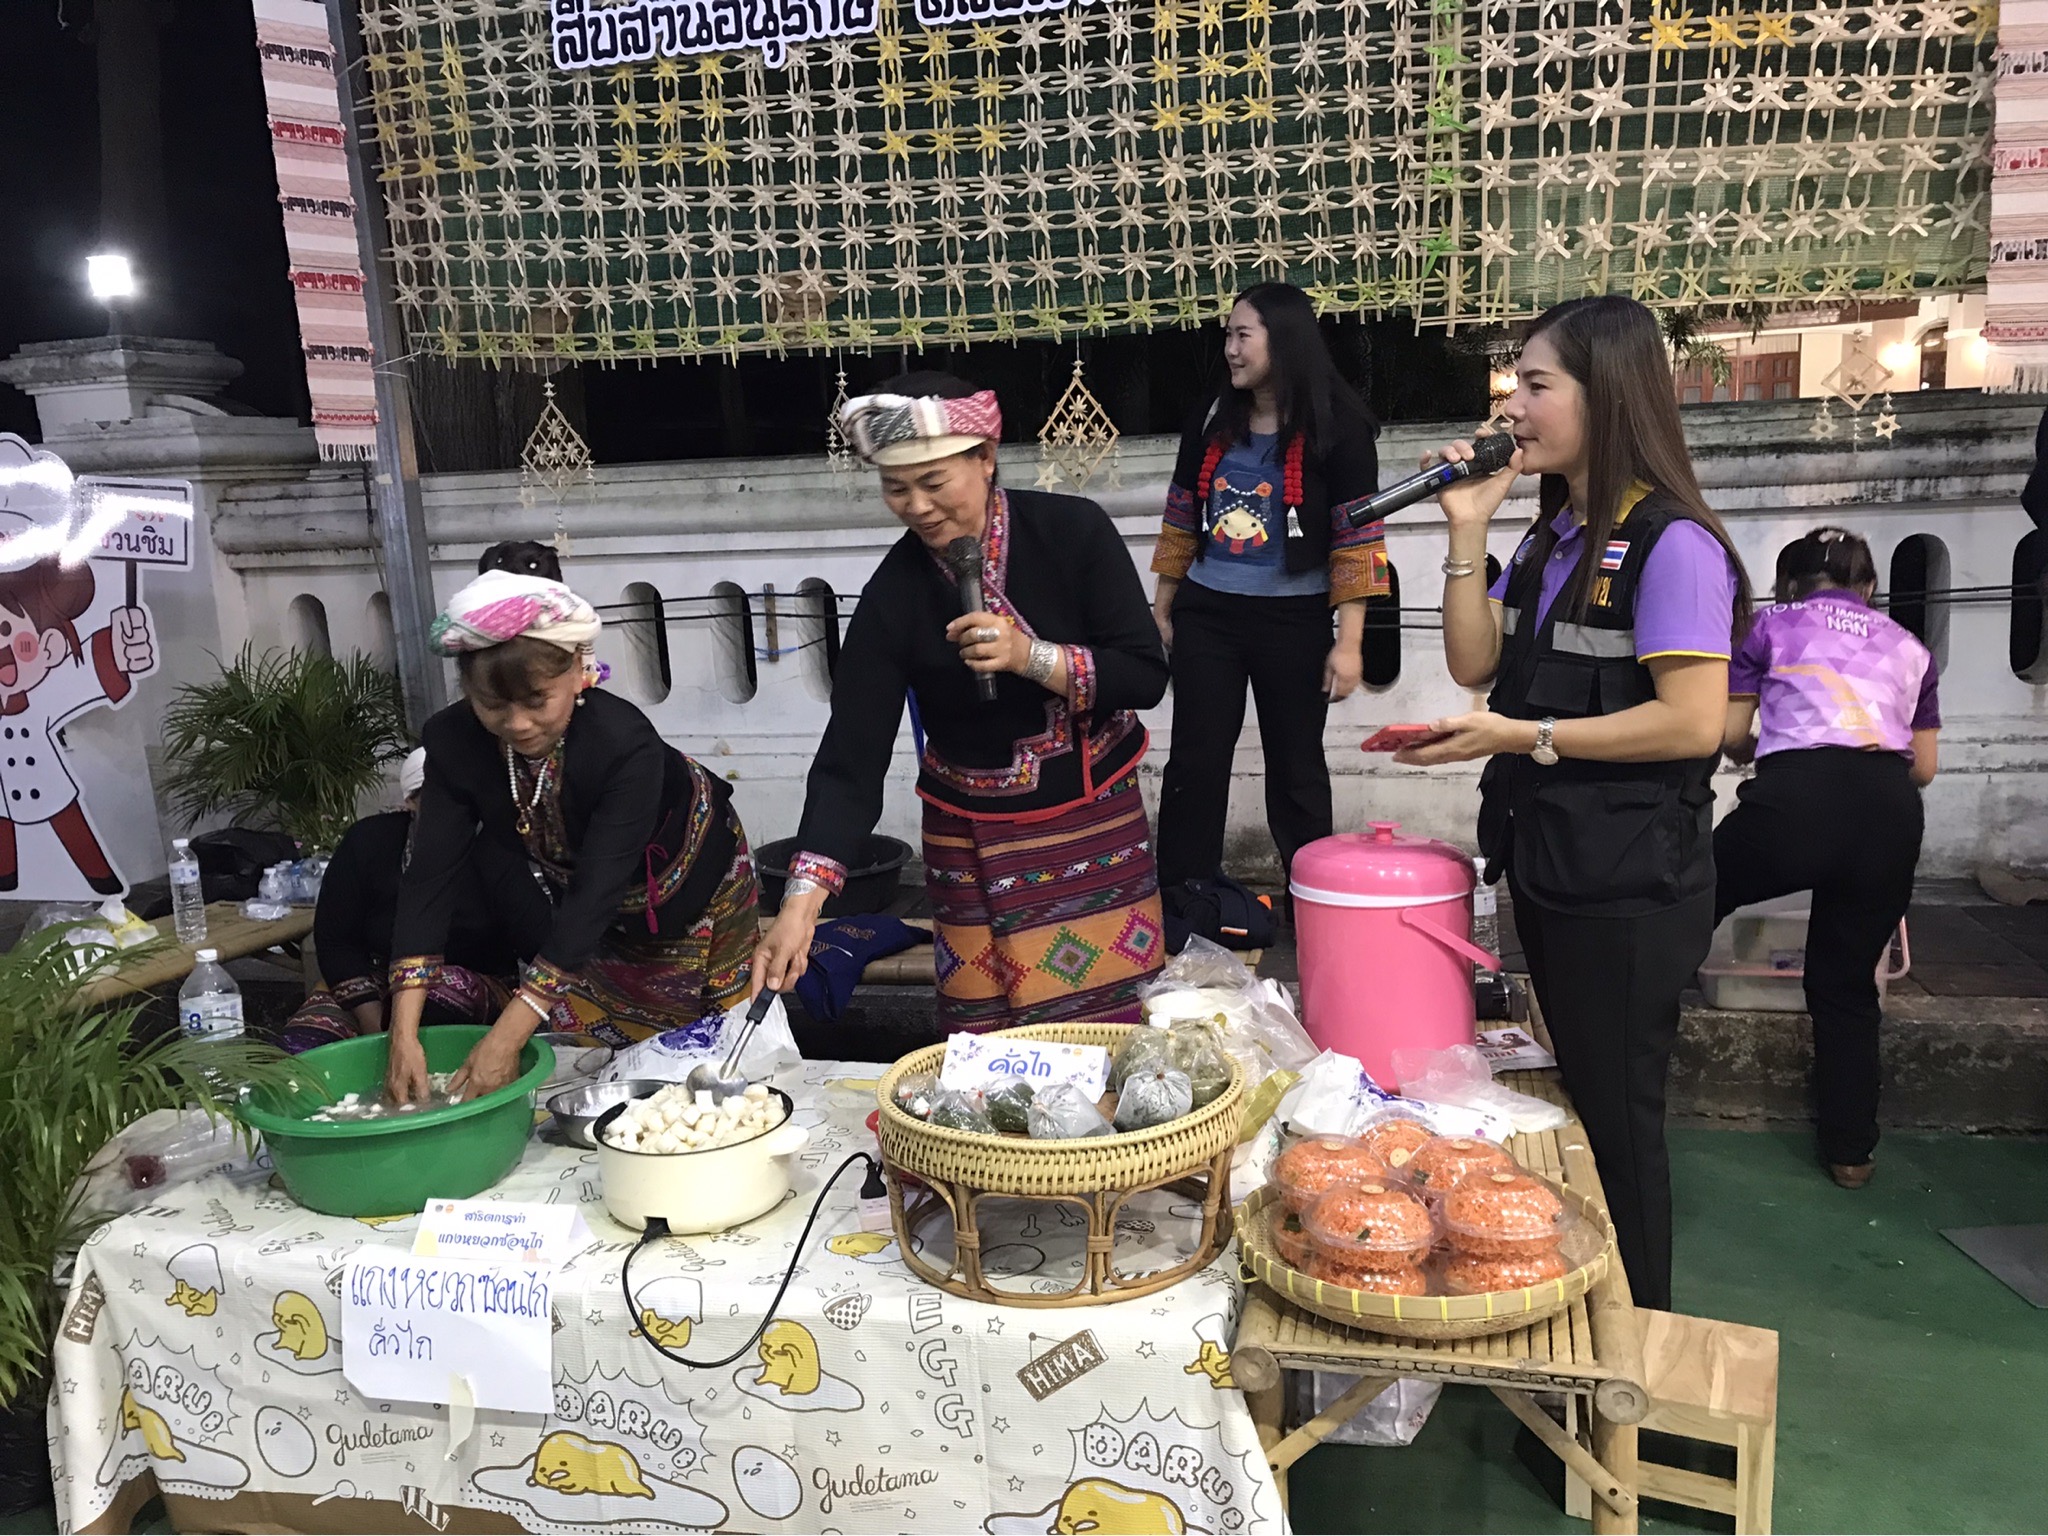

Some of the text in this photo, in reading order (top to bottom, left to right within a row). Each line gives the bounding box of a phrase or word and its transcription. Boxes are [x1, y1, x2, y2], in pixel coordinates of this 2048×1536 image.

[101, 525, 174, 556] วนชิม
[1826, 614, 1869, 638] NAN
[988, 1048, 1052, 1077] คั่วไก
[1024, 1342, 1096, 1394] HIMA
[325, 1419, 434, 1467] gudetama
[812, 1463, 939, 1514] gudetama
